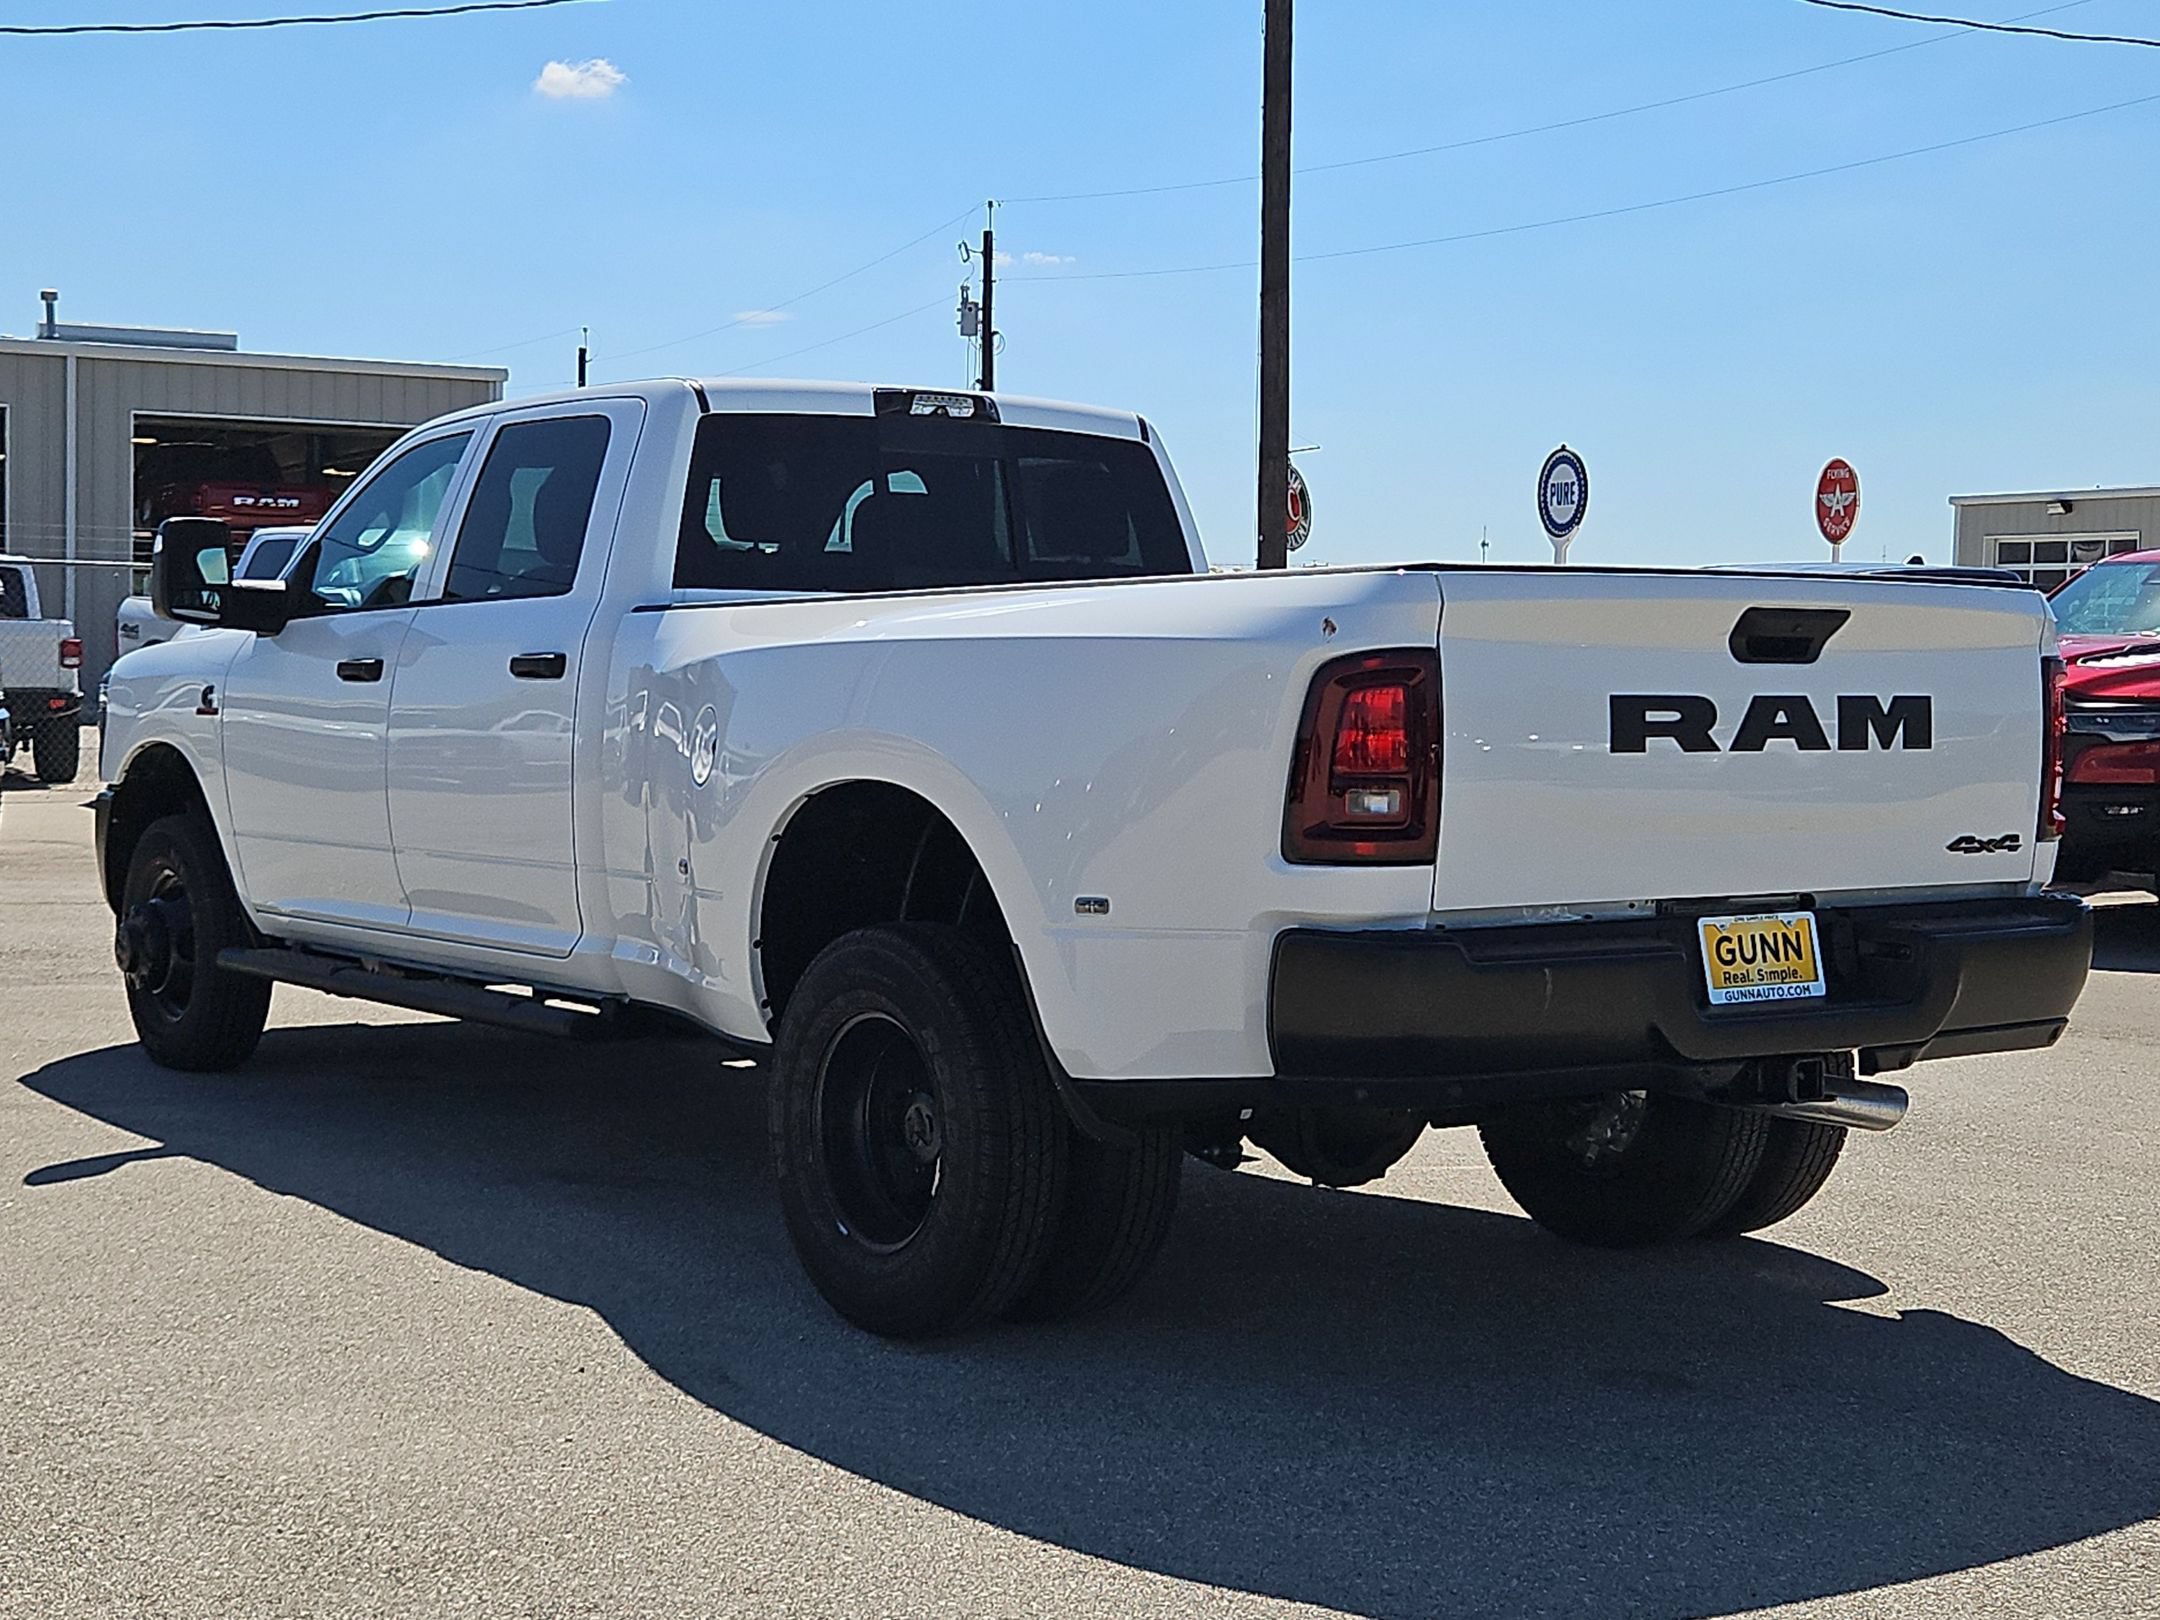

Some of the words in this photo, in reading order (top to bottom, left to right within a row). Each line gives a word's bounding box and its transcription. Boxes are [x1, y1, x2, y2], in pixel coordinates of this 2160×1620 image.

[233, 497, 300, 508] RAM
[1550, 481, 1576, 507] PURE
[1609, 694, 1933, 754] RAM
[1715, 930, 1803, 967] GUNN
[1723, 969, 1754, 985] Real.
[1757, 966, 1803, 984] Simple.
[1724, 984, 1812, 1002] GUNNAUTO.COM
